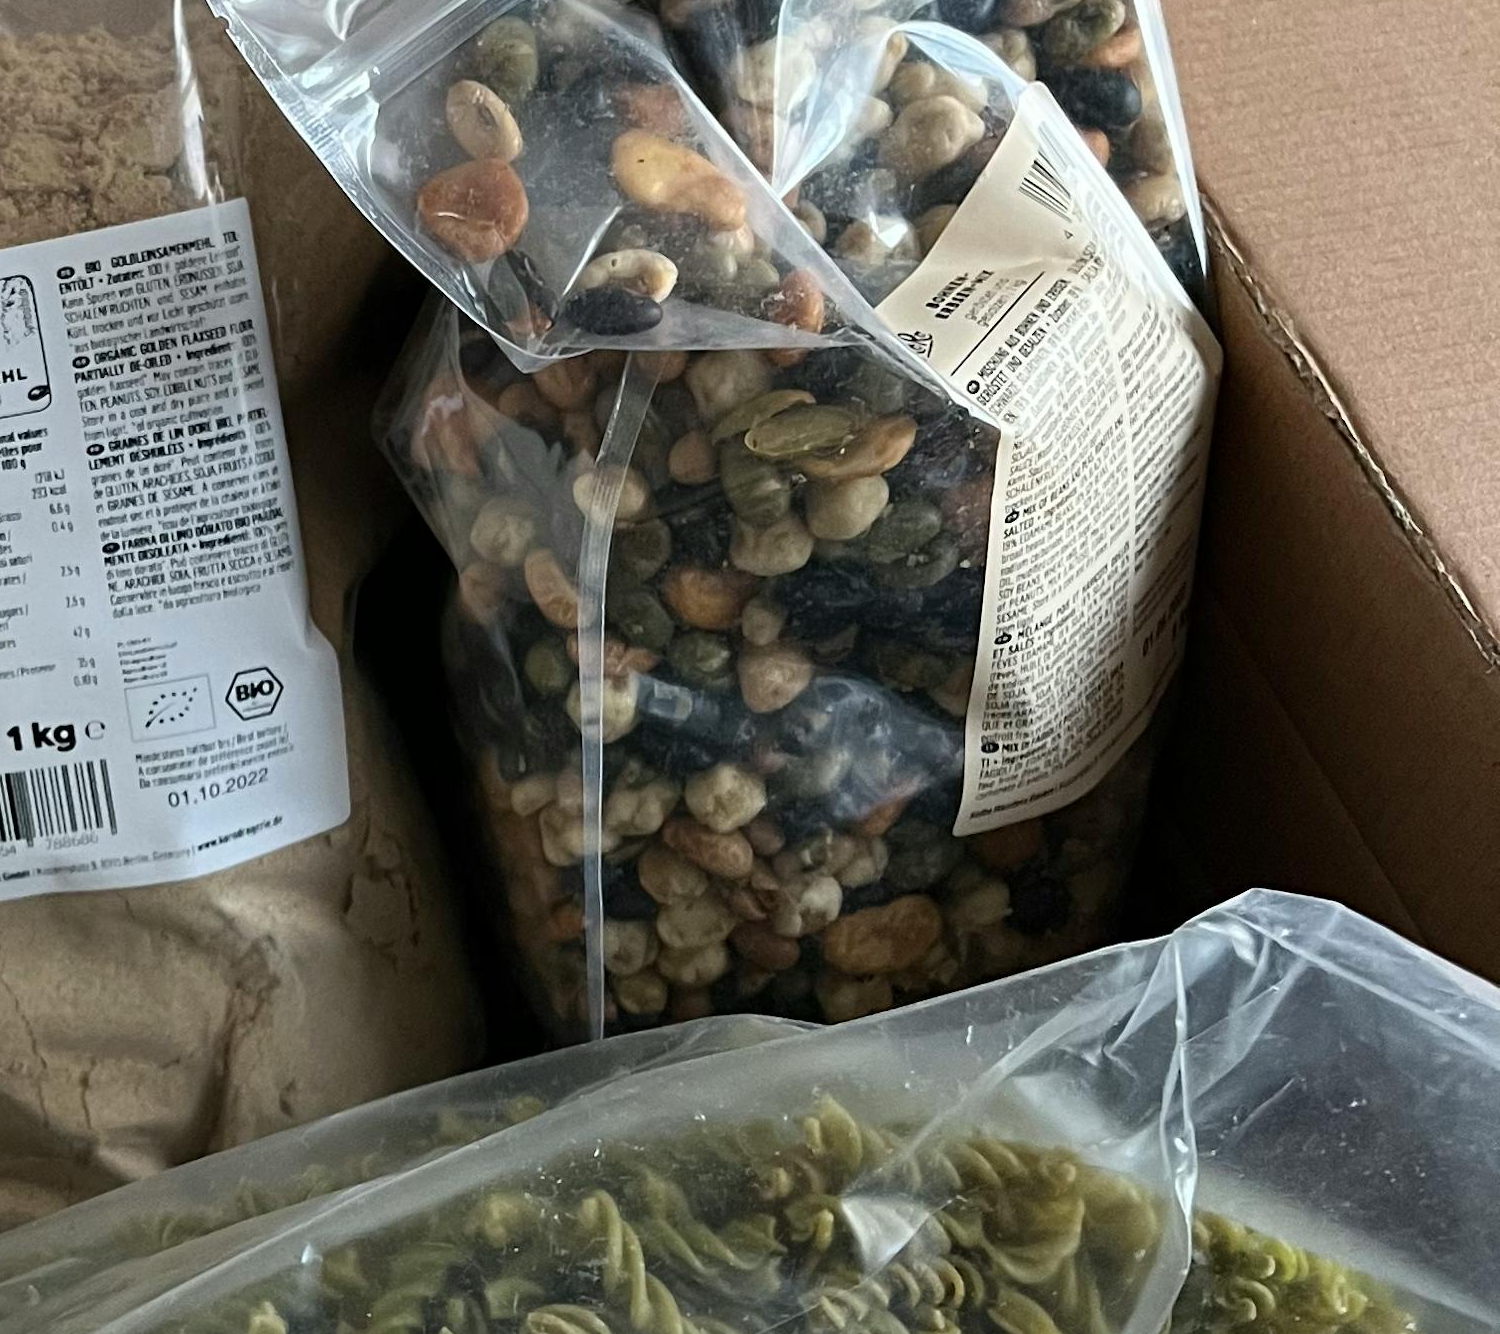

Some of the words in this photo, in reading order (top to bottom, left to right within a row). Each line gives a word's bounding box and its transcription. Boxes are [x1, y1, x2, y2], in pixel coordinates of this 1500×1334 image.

[235, 678, 274, 702] BIO
[7, 726, 23, 751] 1
[32, 723, 76, 752] kg
[168, 768, 268, 807] 01.10.2022
